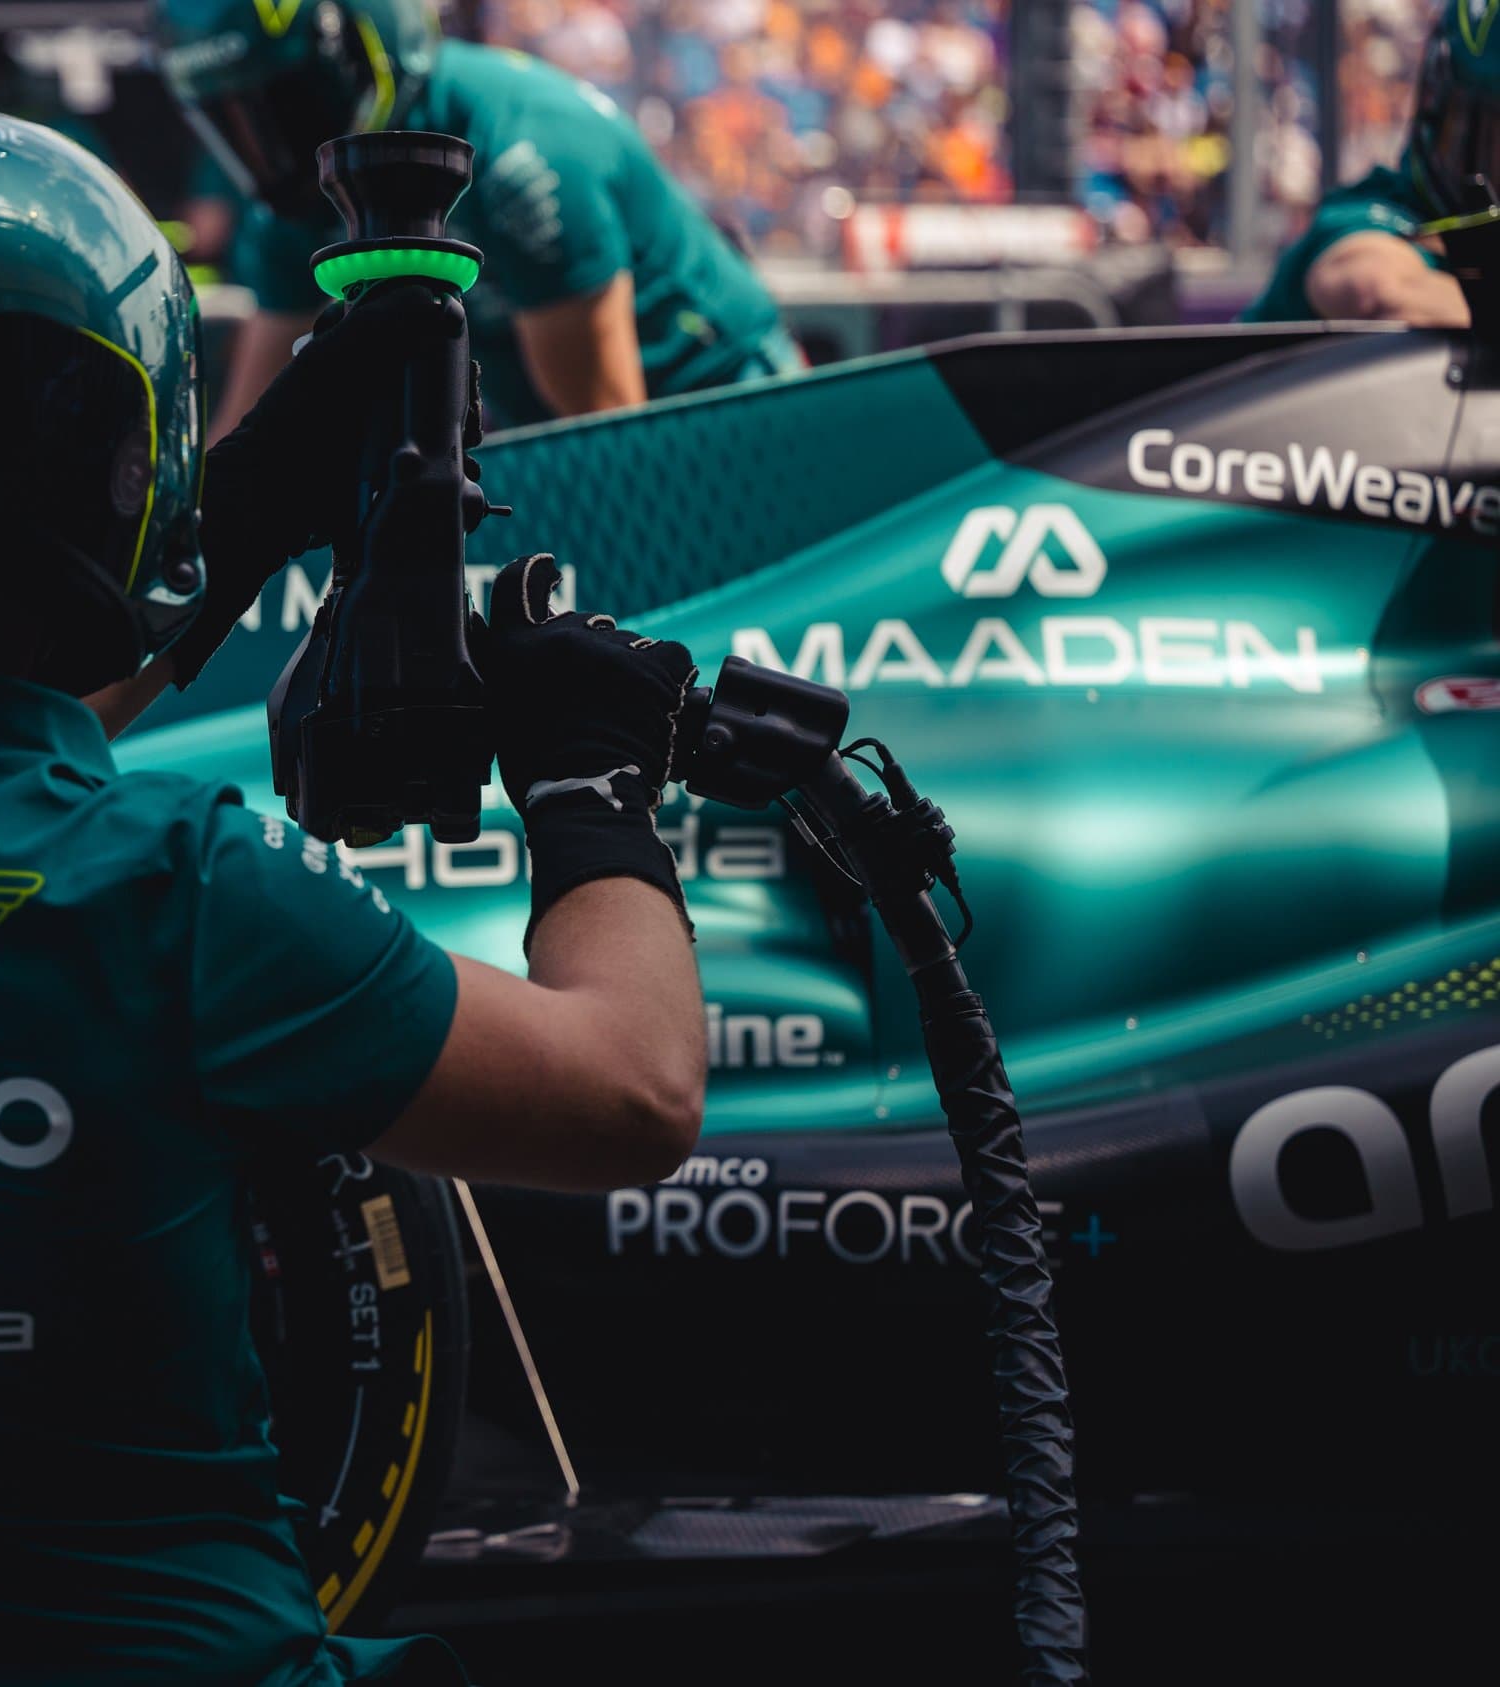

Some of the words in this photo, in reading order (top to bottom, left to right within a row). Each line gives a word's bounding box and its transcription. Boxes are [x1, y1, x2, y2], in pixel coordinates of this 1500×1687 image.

[1127, 428, 1500, 536] CoreWeave
[730, 616, 1324, 693] MAADEN
[336, 812, 787, 891] Hoda
[660, 1154, 769, 1188] mco
[1229, 1043, 1500, 1253] ar
[349, 1281, 381, 1350] SET
